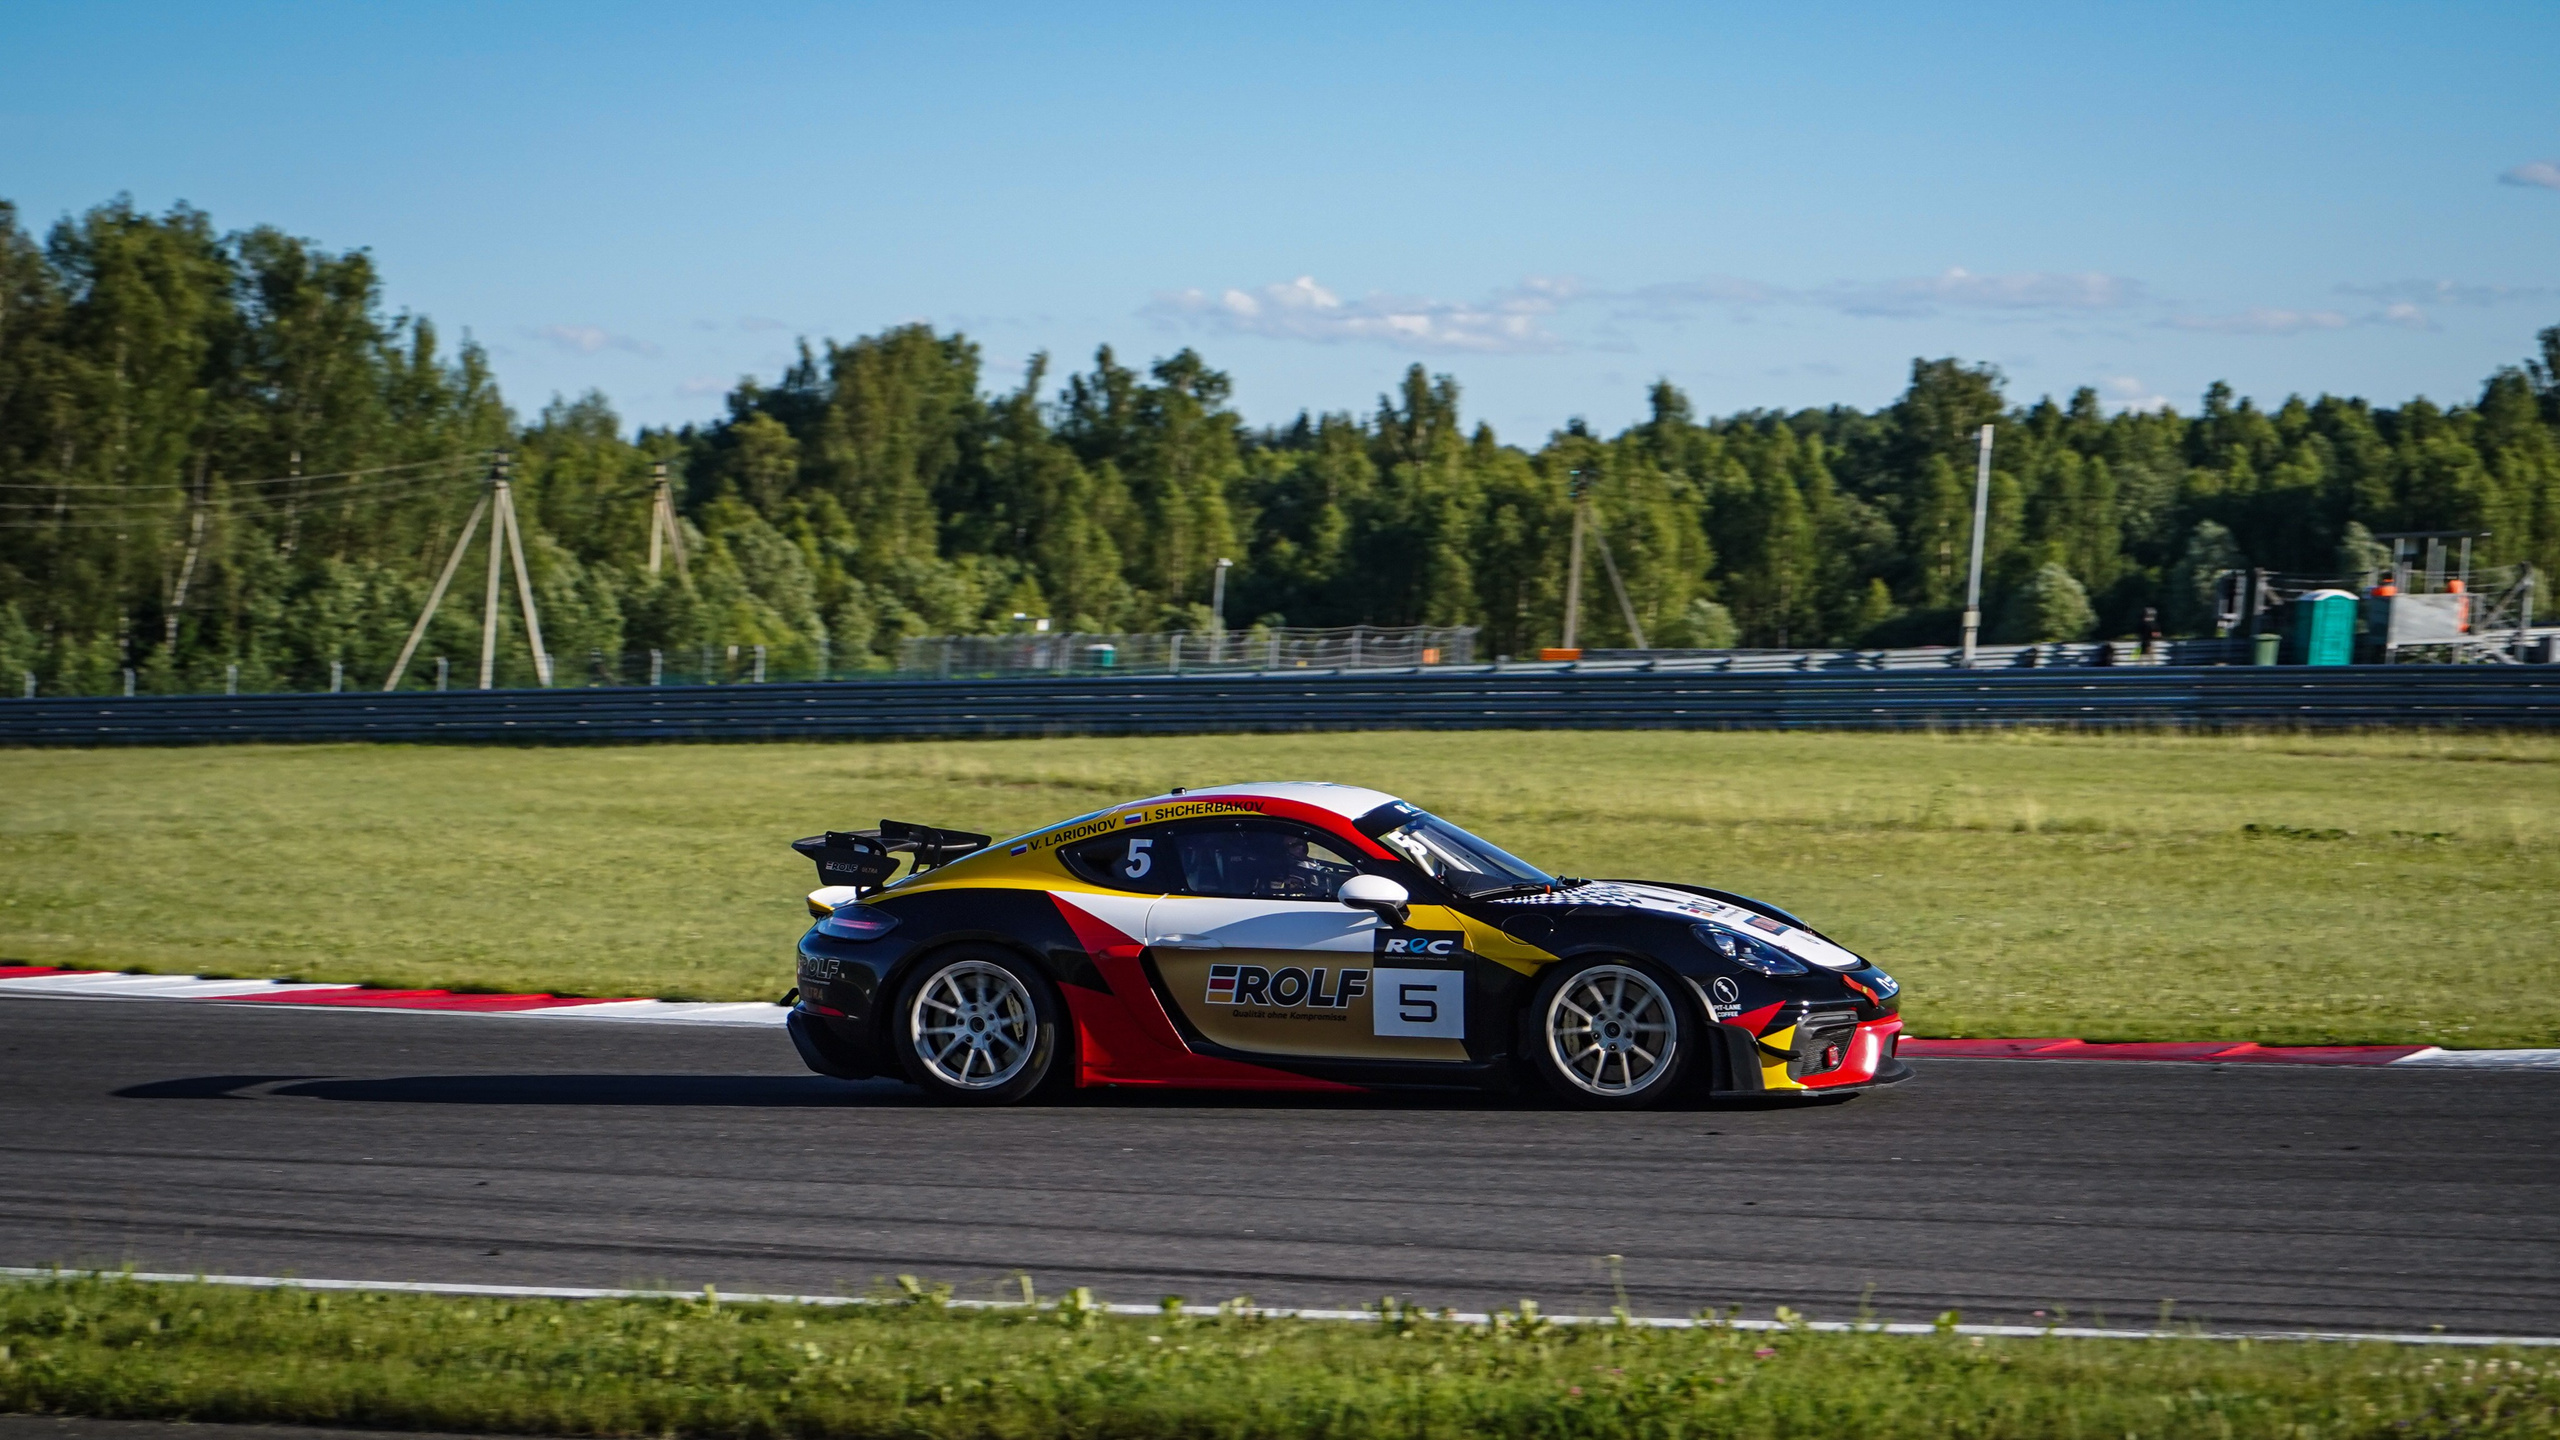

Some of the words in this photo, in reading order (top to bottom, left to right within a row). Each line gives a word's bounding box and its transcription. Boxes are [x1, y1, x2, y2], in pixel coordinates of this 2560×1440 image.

[1144, 810, 1152, 822] I.
[1154, 801, 1265, 821] SHCHERBAKOV
[1029, 841, 1042, 851] V.
[1045, 818, 1117, 848] LARIONOV
[831, 861, 859, 873] ROLF
[1125, 838, 1154, 879] 5
[1233, 964, 1371, 1009] ROLF
[1399, 983, 1438, 1023] 5
[1267, 1011, 1288, 1020] ohne
[1289, 1011, 1348, 1022] Kompromisse
